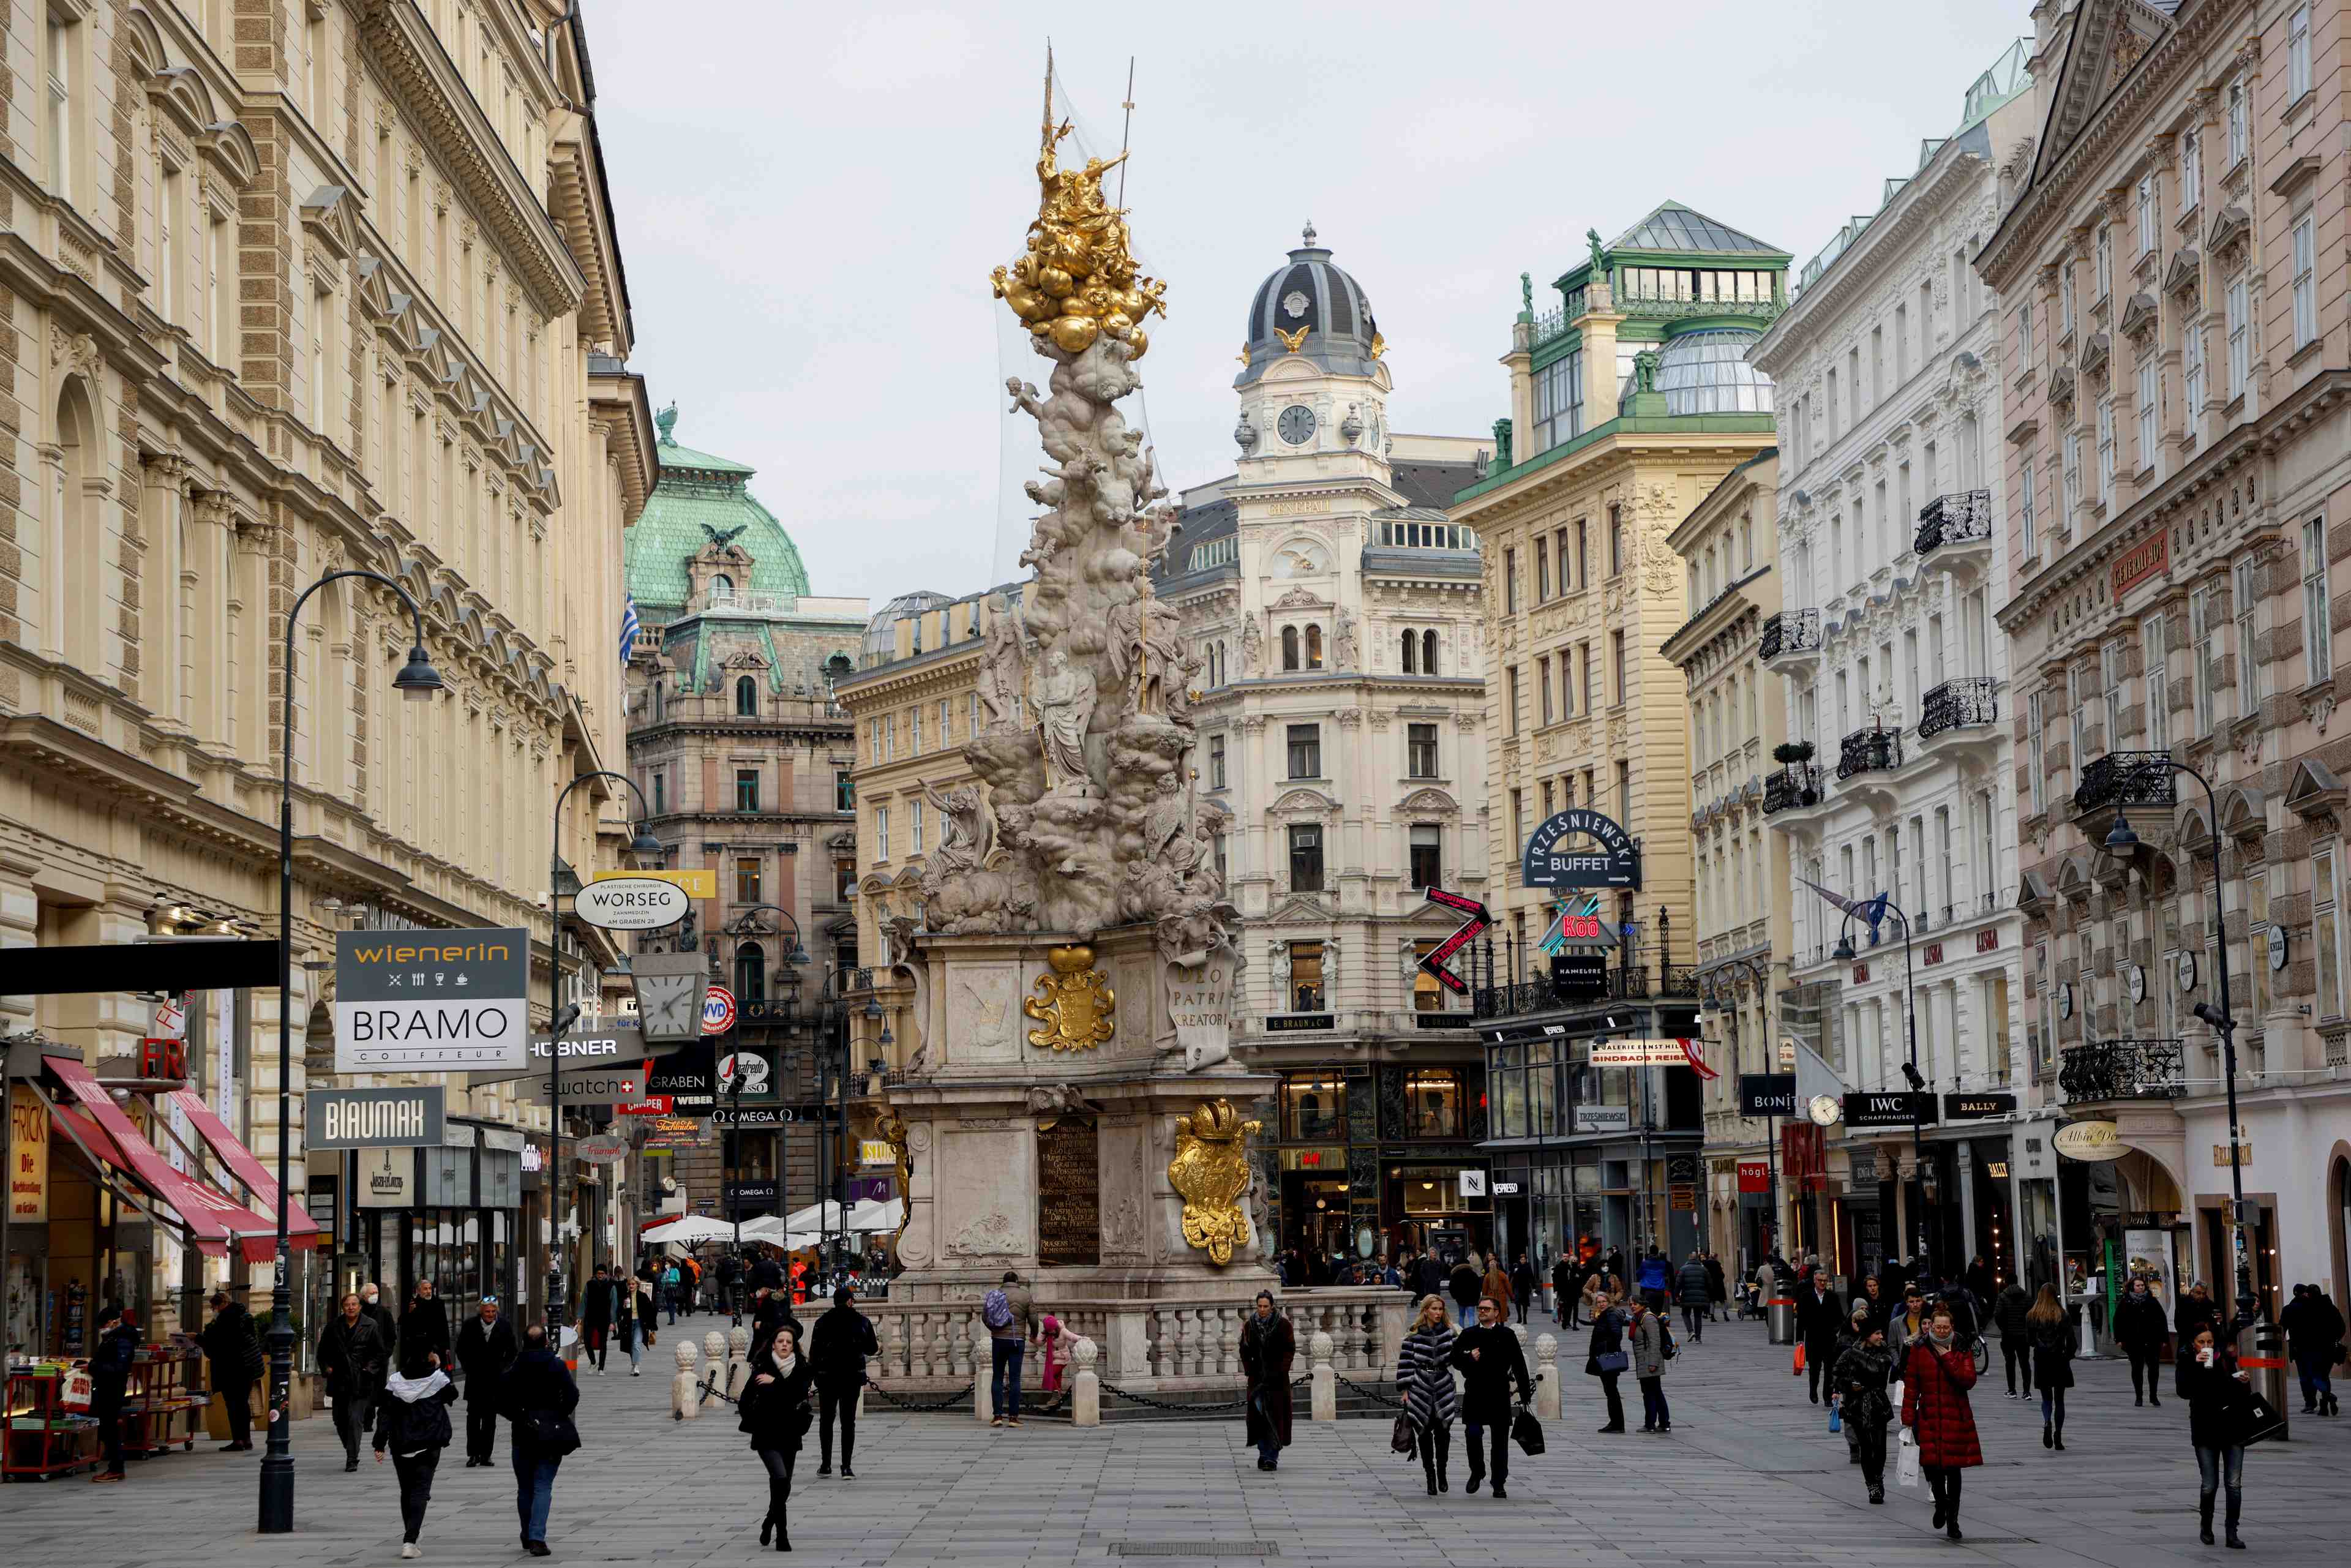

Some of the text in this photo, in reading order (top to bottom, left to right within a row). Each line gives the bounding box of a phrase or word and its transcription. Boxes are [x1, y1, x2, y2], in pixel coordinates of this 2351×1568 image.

[1268, 500, 1332, 516] GENERALI
[1531, 814, 1631, 868] TRZEŚNIEWSKI
[1551, 857, 1611, 871] BUFFET
[592, 892, 671, 907] WORSEG
[1430, 889, 1480, 910] DISCOTHEQUE
[1562, 916, 1599, 937] Köö
[1430, 919, 1484, 967] FLEDERMAUS
[354, 943, 509, 963] wienerin
[1178, 969, 1221, 983] DEO
[1439, 969, 1455, 982] BAR
[1174, 992, 1225, 1005] PATRI
[353, 1008, 508, 1041] BRAMO
[1175, 1013, 1227, 1026] CREATORI
[1283, 1020, 1309, 1029] BRAUN
[360, 1050, 501, 1060] COIFFEUR
[542, 1078, 619, 1095] swatch
[650, 1076, 705, 1088] GRABEN
[677, 1095, 714, 1105] WEBER
[1870, 1097, 1903, 1112] IWC
[1960, 1103, 1997, 1111] BALLY
[729, 1111, 775, 1122] OMEGA
[1579, 1111, 1627, 1121] TRZEŚNIEWSKI
[585, 1144, 620, 1156] Triumph
[21, 1153, 34, 1173] Die
[1988, 1163, 2008, 1177] BALLY
[1741, 1167, 1766, 1177] högl
[1492, 1181, 1518, 1195] NESPRESSO
